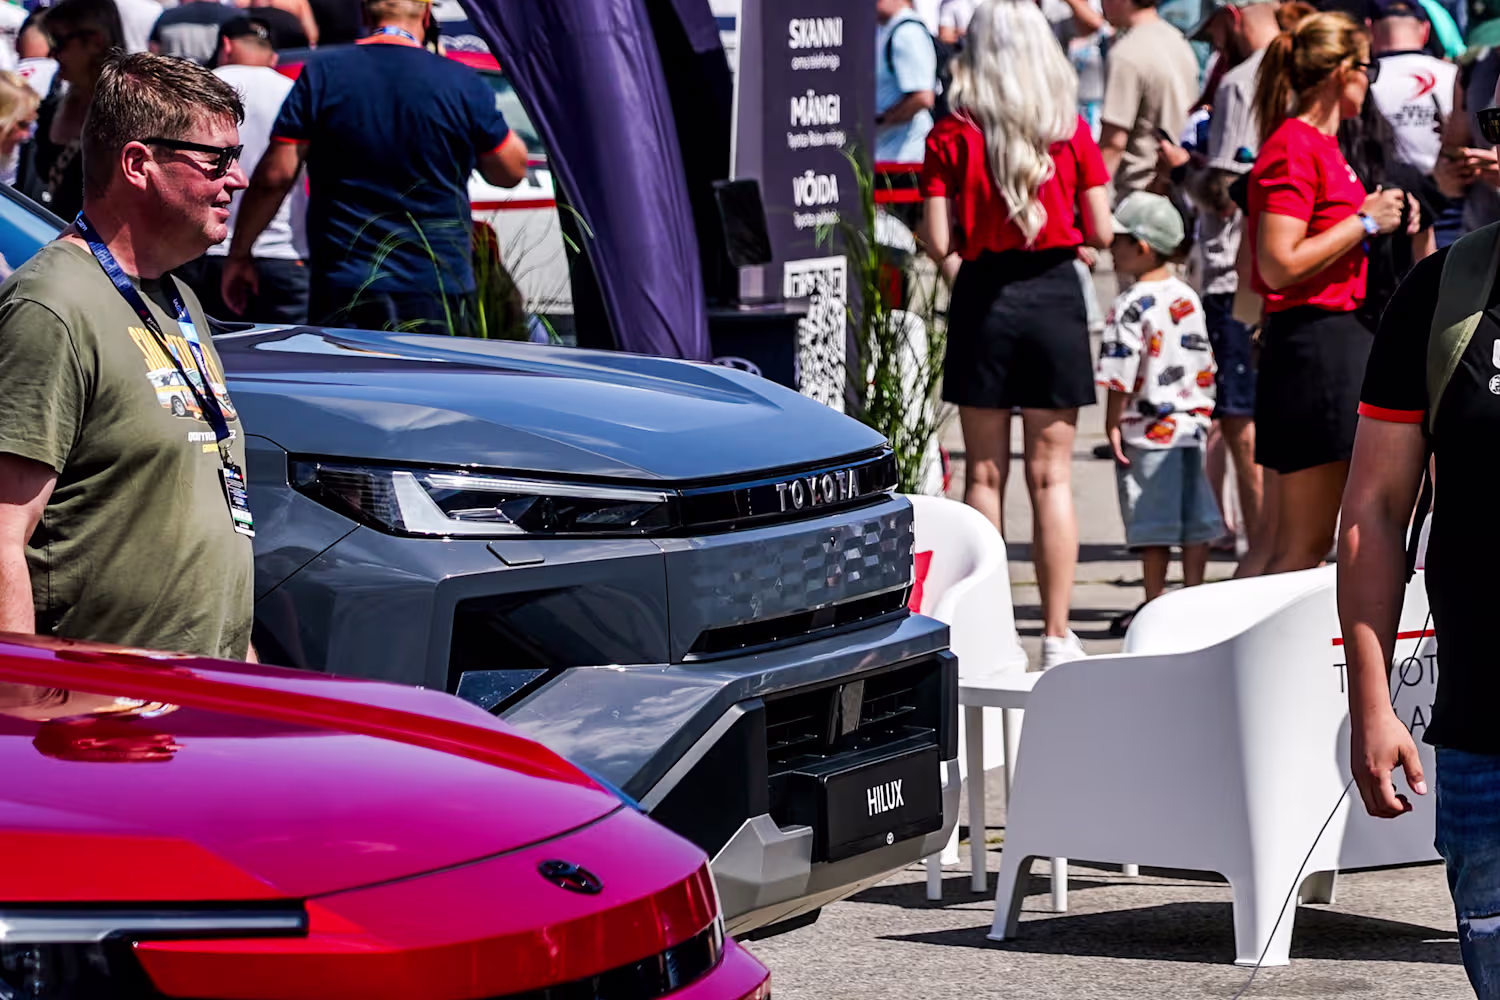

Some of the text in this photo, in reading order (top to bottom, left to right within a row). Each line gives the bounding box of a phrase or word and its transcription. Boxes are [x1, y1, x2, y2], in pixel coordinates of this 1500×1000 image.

[788, 16, 843, 49] SKANNI
[775, 468, 860, 513] TOYOTA
[867, 778, 905, 817] HILUX
